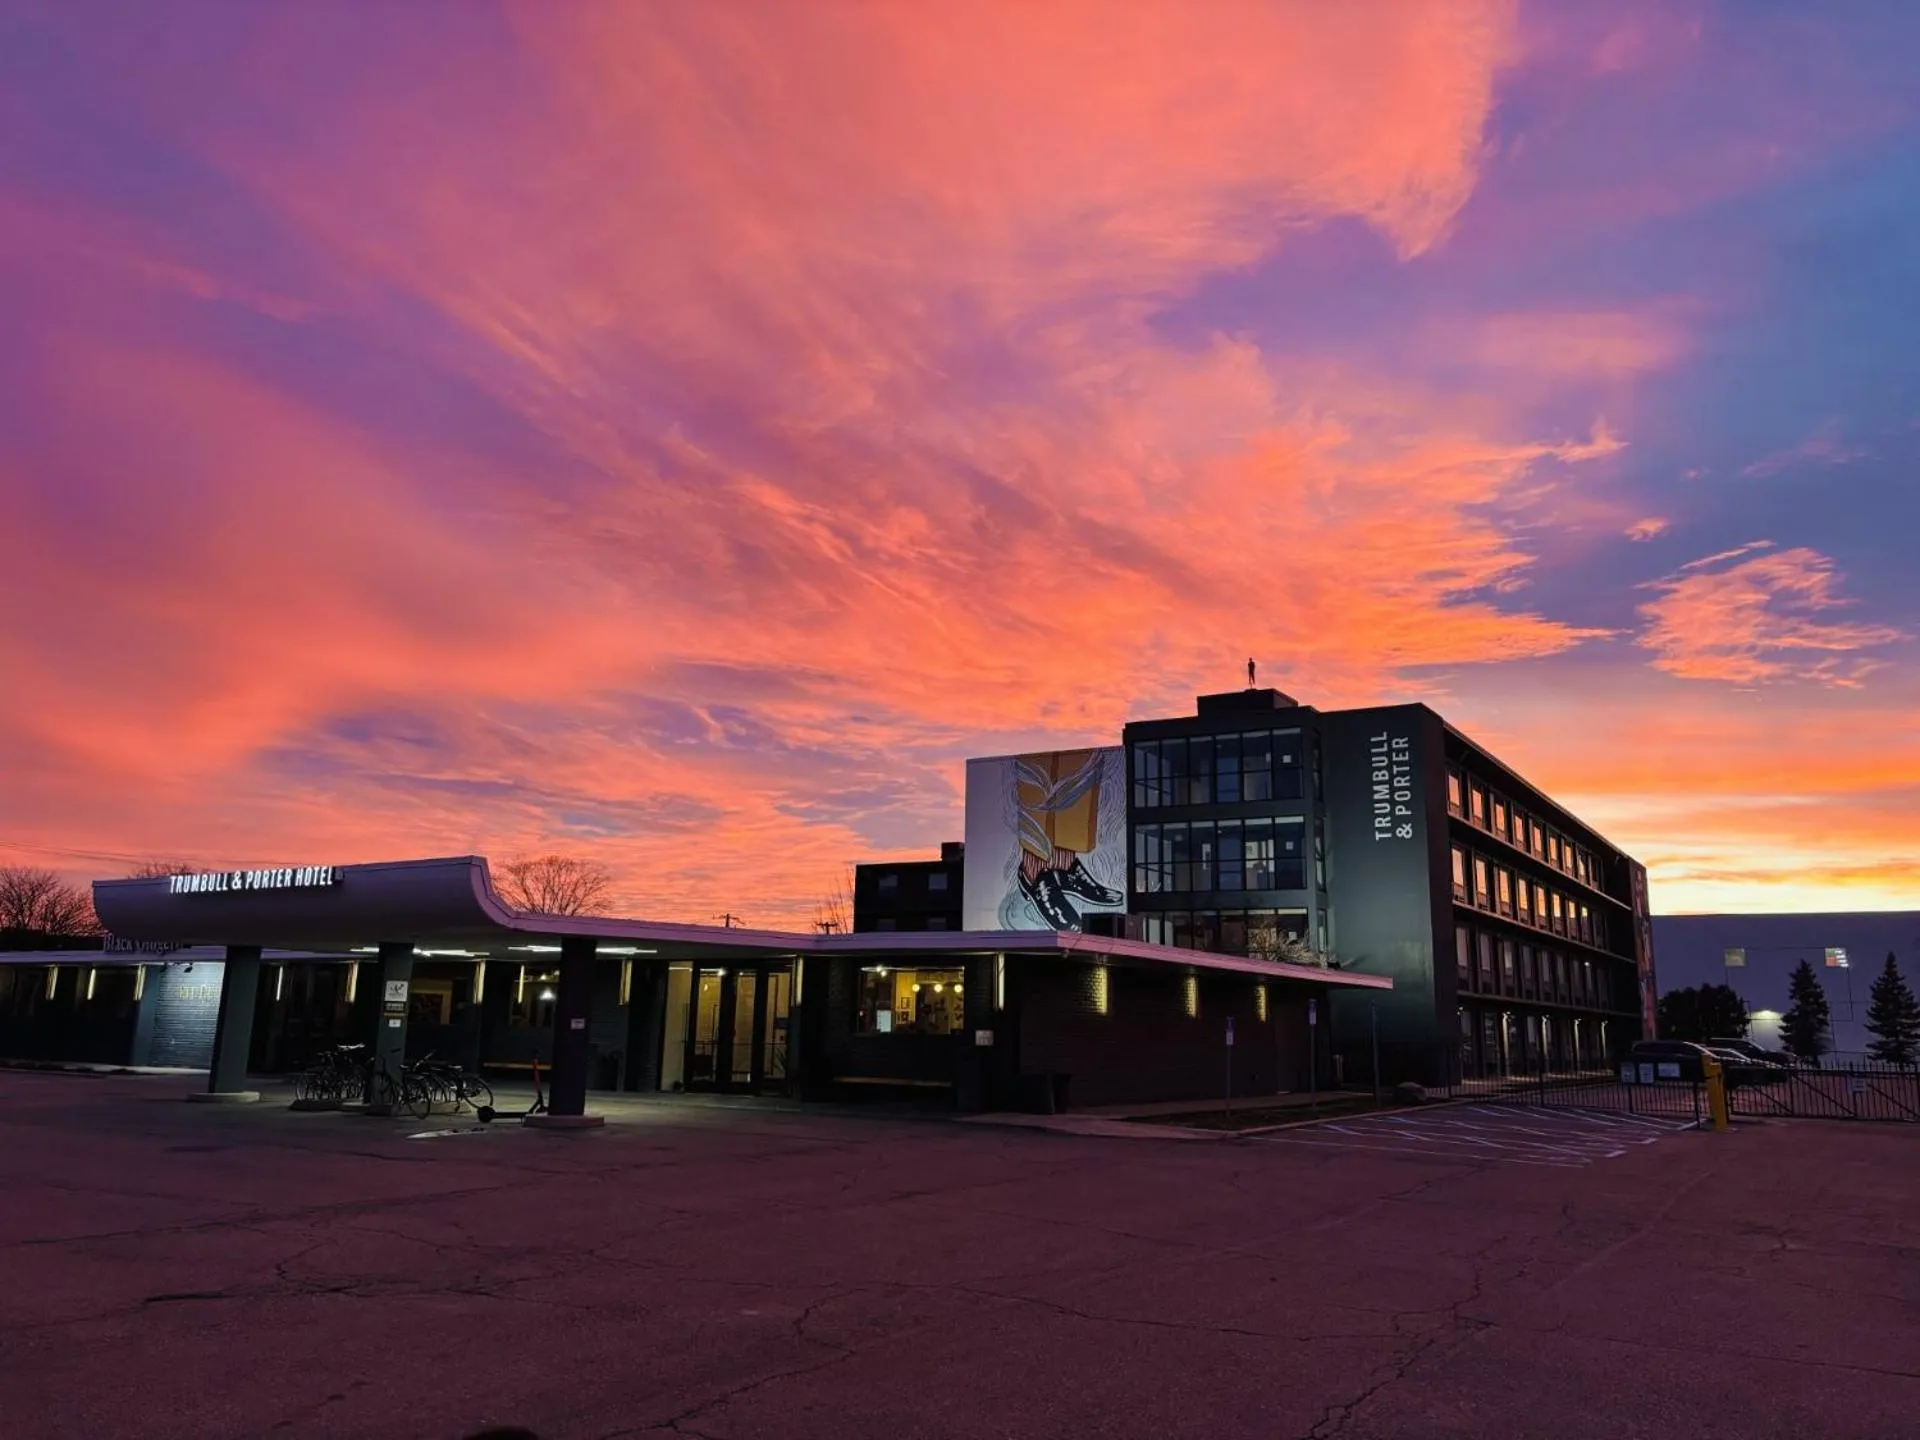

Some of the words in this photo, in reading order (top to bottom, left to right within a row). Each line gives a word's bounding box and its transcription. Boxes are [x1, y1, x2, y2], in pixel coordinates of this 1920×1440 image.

[1370, 731, 1393, 841] TRUMBULL
[1392, 737, 1412, 815] PORTER
[1395, 823, 1413, 839] &
[170, 873, 229, 894] TRUMBULL
[231, 870, 242, 890] &
[245, 868, 292, 890] PORTER
[295, 865, 333, 887] HOTEL
